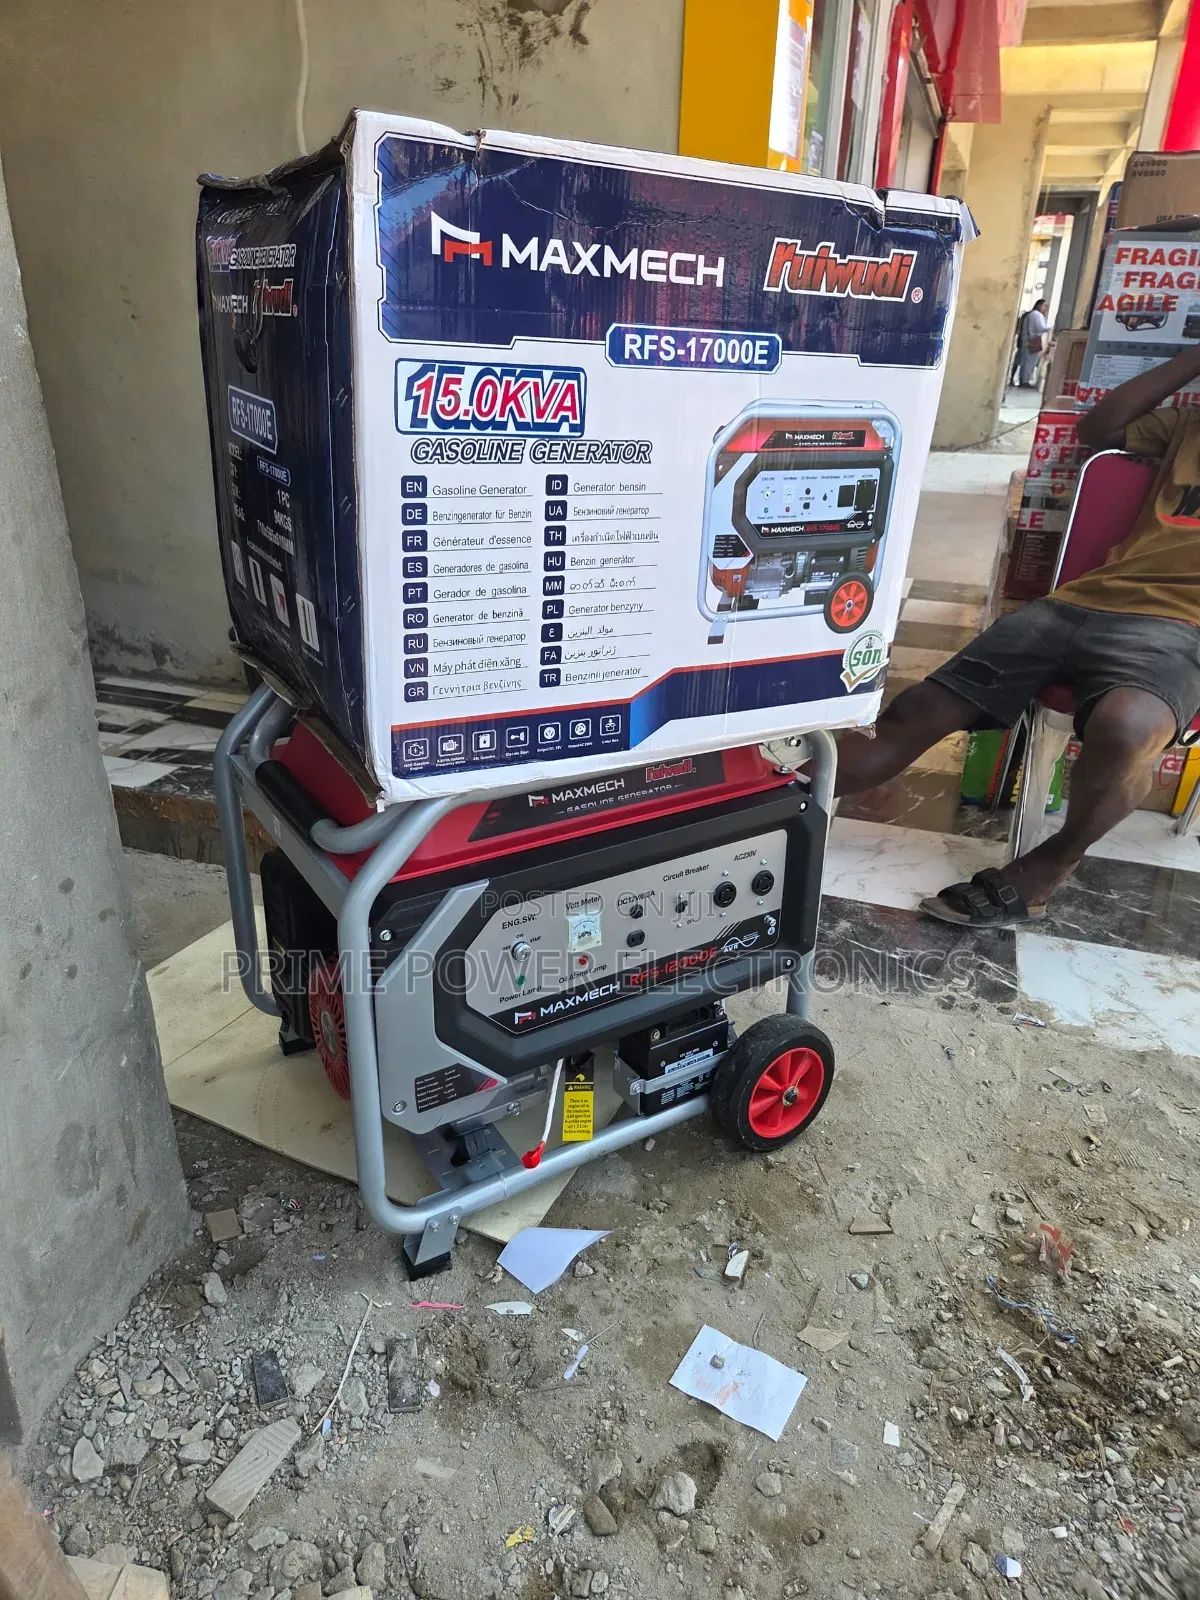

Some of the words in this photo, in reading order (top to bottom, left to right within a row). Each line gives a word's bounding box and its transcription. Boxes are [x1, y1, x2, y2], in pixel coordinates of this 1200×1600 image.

[502, 236, 724, 288] MAXMECH
[1115, 247, 1200, 266] FRAGI
[1123, 271, 1200, 289] FRAG
[624, 335, 769, 366] RFS-17000E
[404, 363, 580, 430] 15.0KVA
[232, 396, 273, 441] RFS-17000E
[411, 437, 526, 464] GASOLINE
[529, 438, 652, 464] GENERATOR
[260, 460, 288, 482] RFS-17000E
[406, 482, 422, 492] EN
[432, 485, 477, 496] Gasoline
[479, 484, 527, 495] Generator
[552, 480, 562, 490] ID
[573, 482, 615, 492] Generator
[620, 482, 646, 492] bensin
[406, 509, 422, 520] DE
[432, 510, 492, 522] Benzingenerator
[496, 509, 505, 519] für
[508, 509, 532, 519] Benzin
[548, 506, 563, 516] UA
[573, 506, 615, 516] Бензиновий
[616, 507, 650, 516] генератор
[549, 531, 562, 541] TH
[770, 525, 805, 534] MAXMECH
[406, 536, 422, 546] FR
[433, 536, 484, 547] Générateur
[488, 535, 532, 545] d'essence
[407, 562, 423, 572] ES
[433, 563, 482, 574] Generadores
[486, 562, 495, 571] de
[499, 560, 529, 573] gasolina
[547, 557, 562, 566] HU
[570, 557, 596, 566] Benzin
[600, 555, 635, 567] generátor
[408, 588, 422, 598] PT
[433, 588, 470, 599] Gerador
[476, 588, 486, 597] de
[491, 586, 527, 597] gasolina
[546, 581, 562, 591] MM
[547, 605, 559, 614] PL
[568, 605, 608, 615] Generator
[610, 602, 643, 613] benzyny
[408, 613, 424, 624] RO
[433, 613, 474, 623] Generator
[478, 611, 488, 620] de
[492, 608, 523, 619] benzină
[567, 626, 592, 638] البنزين
[597, 625, 614, 635] مولد
[408, 639, 424, 648] RU
[433, 635, 484, 647] Бензиновый
[486, 633, 526, 643] генератор
[545, 651, 557, 660] FA
[408, 663, 424, 673] VN
[433, 662, 453, 675] Máy
[454, 660, 477, 674] phát
[500, 657, 521, 668] xăng
[544, 674, 557, 682] TR
[565, 670, 601, 682] Benzinli
[602, 667, 641, 680] jeneratör
[408, 688, 424, 697] GR
[552, 778, 625, 804] MAXMECH
[566, 798, 614, 813] GASOLINE
[618, 784, 672, 801] GENERATOR
[734, 850, 757, 862] AC230V
[663, 869, 684, 882] Circuit
[684, 864, 710, 877] Breaker
[566, 900, 580, 911] Volt
[580, 896, 601, 906] Meter
[502, 913, 537, 930] ENG.SW.
[500, 992, 522, 1003] Power
[540, 982, 620, 1017] MAXMECH
